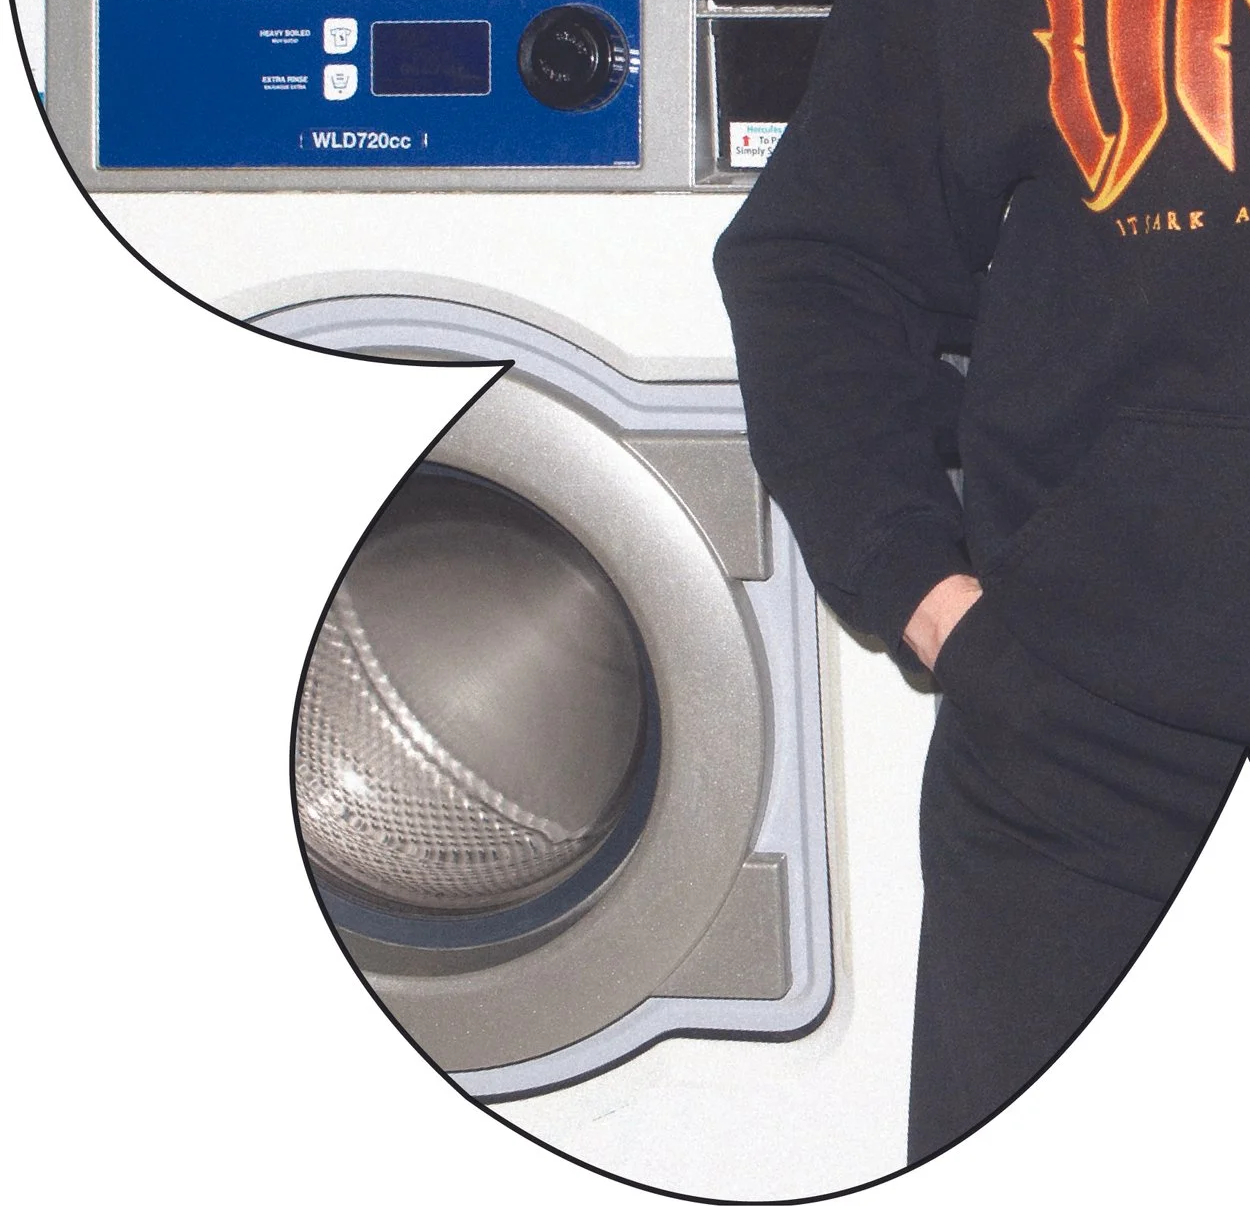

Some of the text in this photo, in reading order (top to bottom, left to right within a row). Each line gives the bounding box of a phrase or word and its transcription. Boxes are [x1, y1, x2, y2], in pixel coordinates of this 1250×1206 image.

[259, 29, 283, 38] HEAVY
[746, 124, 783, 134] Hercules
[311, 131, 412, 150] WLD720cc
[759, 135, 769, 145] To
[735, 146, 766, 157] Simply
